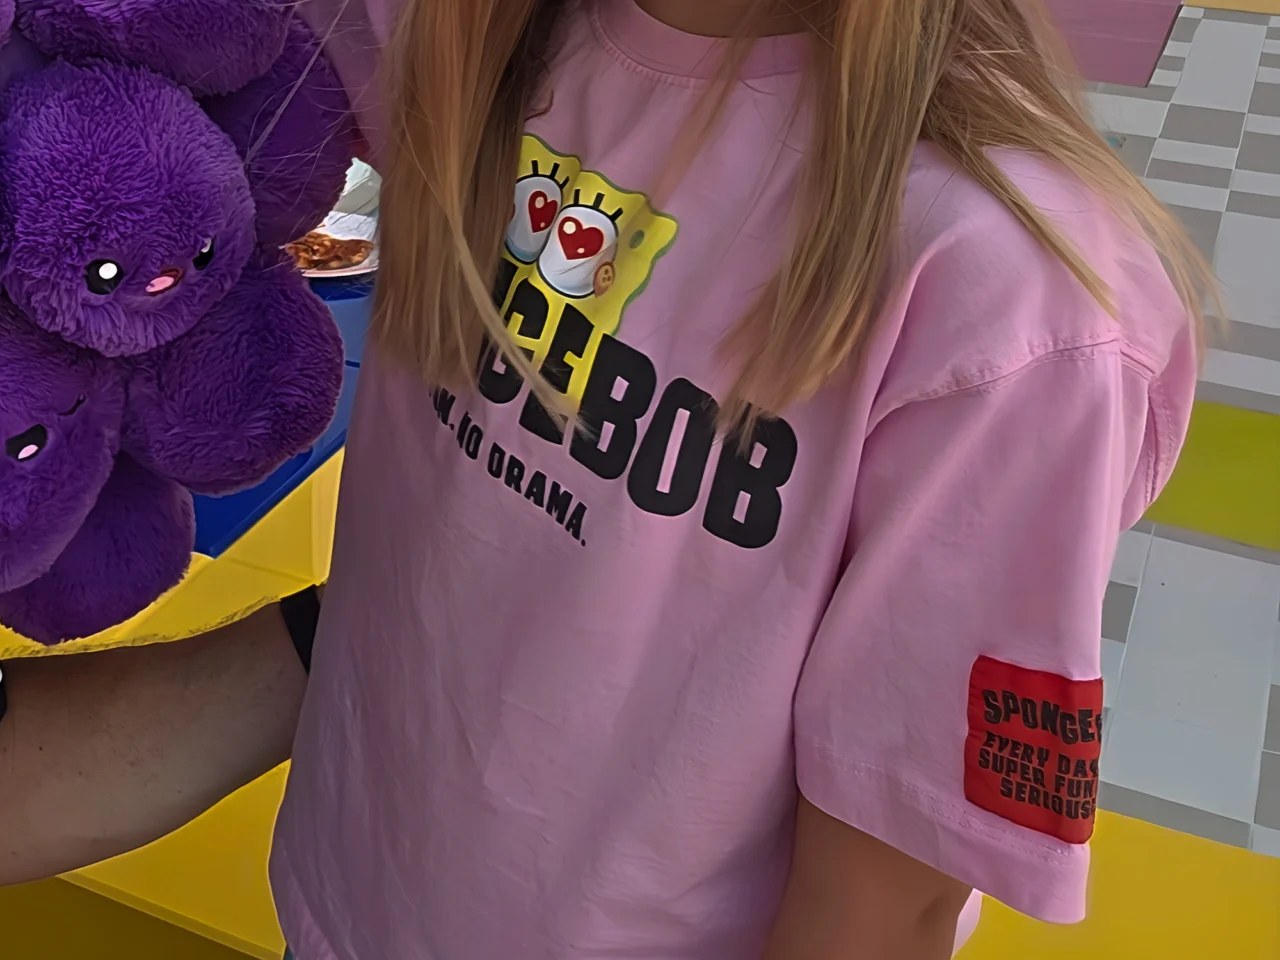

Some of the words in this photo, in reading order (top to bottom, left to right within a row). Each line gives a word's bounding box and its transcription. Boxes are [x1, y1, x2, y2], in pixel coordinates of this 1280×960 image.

[487, 442, 588, 547] DRAMA.
[978, 748, 1045, 788] SUPER
[982, 730, 1050, 767] EVERY
